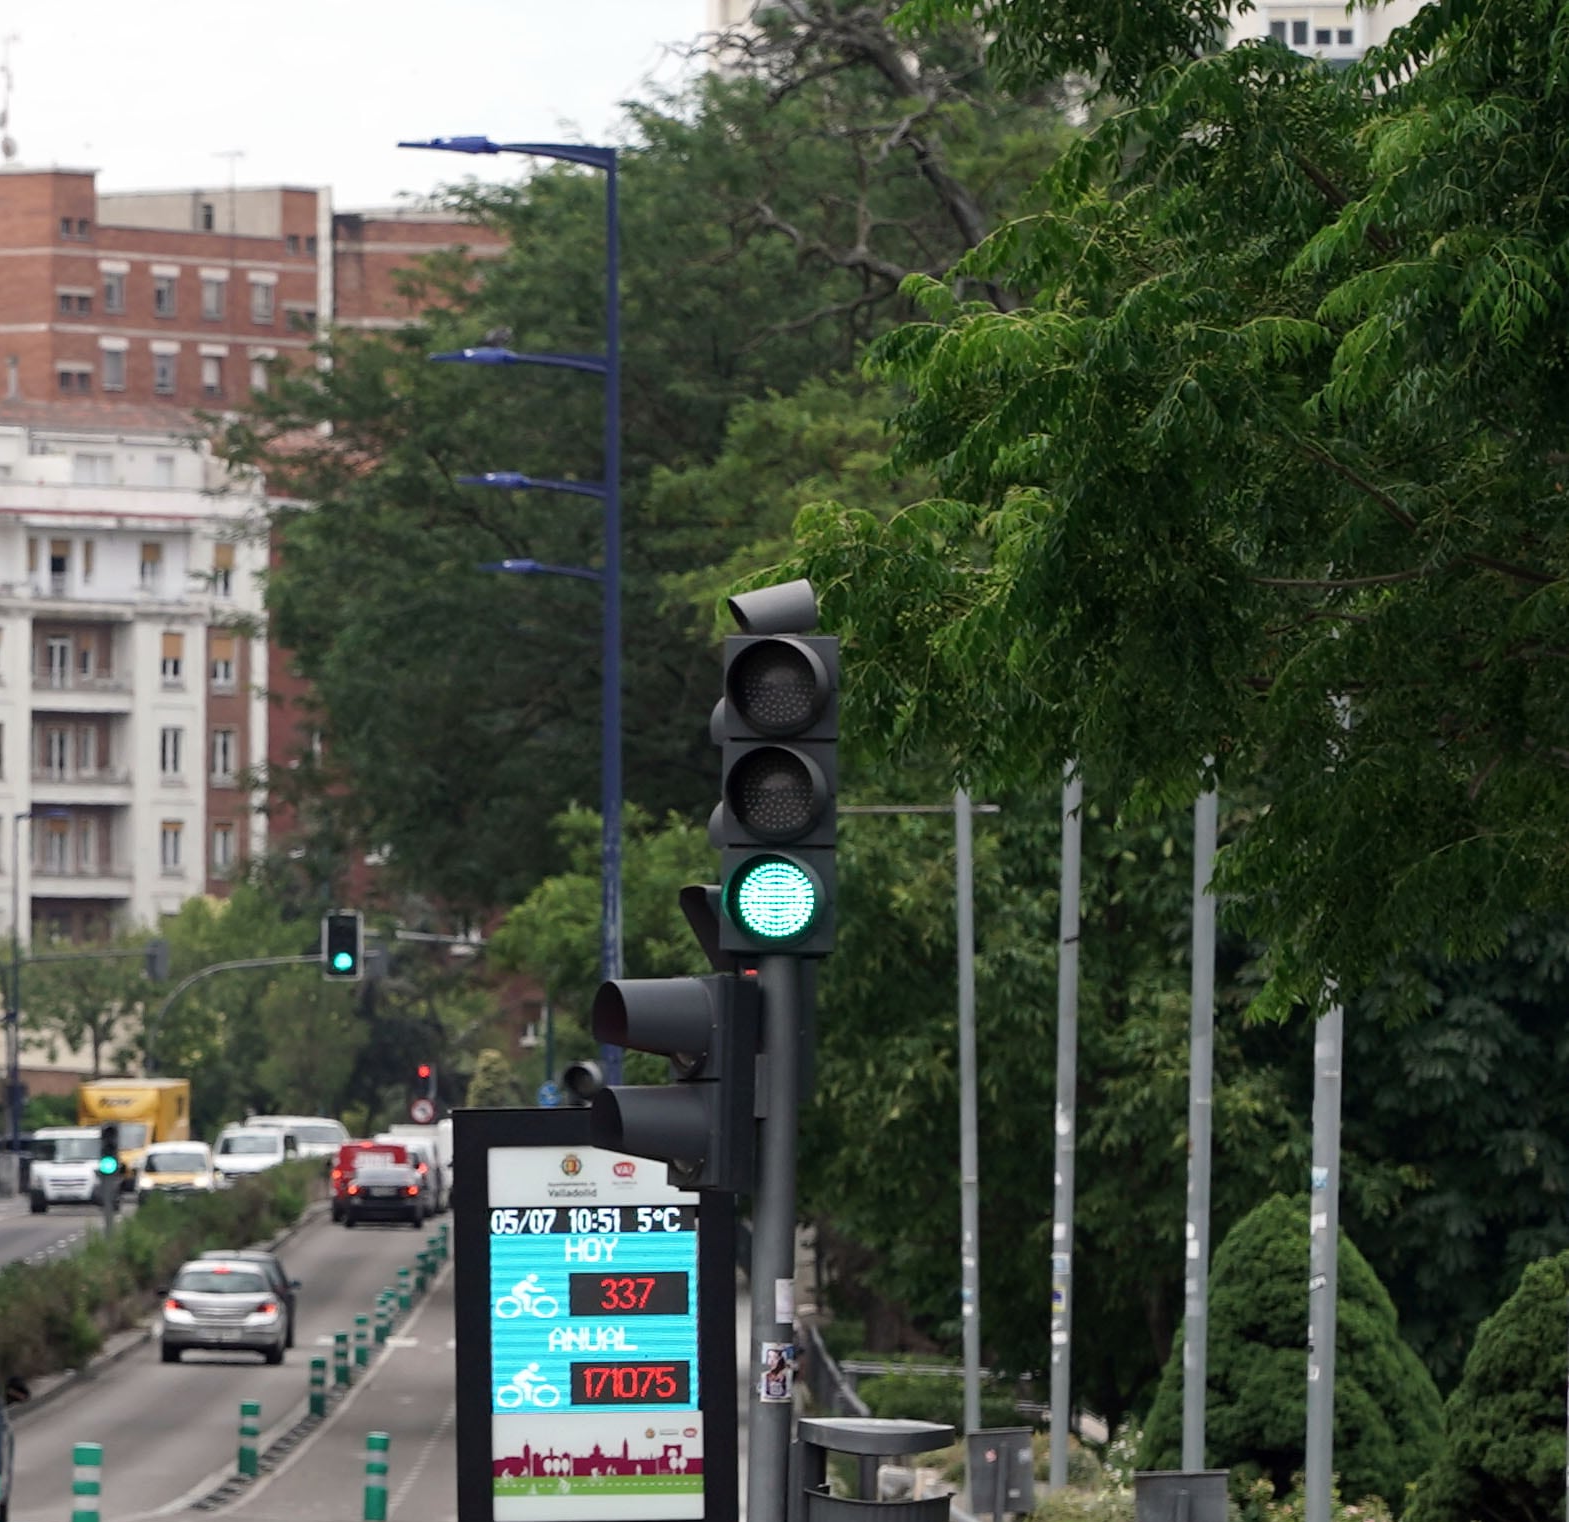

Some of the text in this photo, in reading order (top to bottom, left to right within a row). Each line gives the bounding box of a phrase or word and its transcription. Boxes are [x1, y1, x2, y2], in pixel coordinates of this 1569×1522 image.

[548, 1188, 598, 1198] Valladolid
[490, 1208, 557, 1235] 05/07
[568, 1208, 621, 1233] 10:51
[565, 1237, 619, 1262] HOY
[600, 1278, 655, 1310] 337
[548, 1326, 639, 1352] ANUAL
[582, 1366, 677, 1399] 171075
